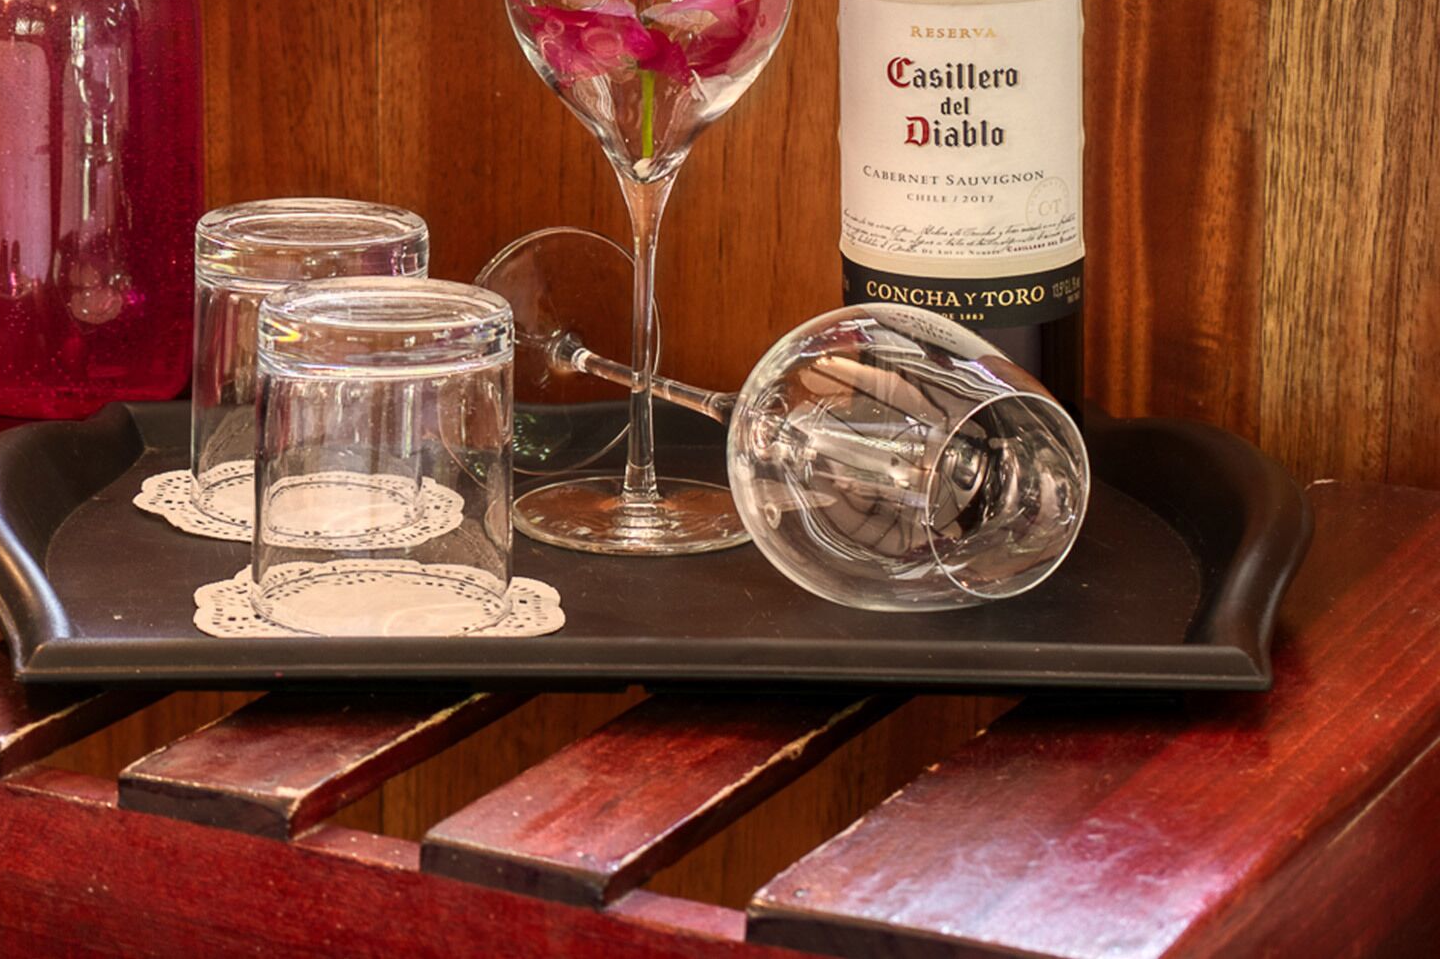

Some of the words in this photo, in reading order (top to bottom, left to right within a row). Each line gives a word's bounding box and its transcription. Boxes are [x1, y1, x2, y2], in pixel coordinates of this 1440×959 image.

[910, 25, 997, 39] RESERVA
[886, 56, 1019, 90] Casillero
[940, 96, 970, 116] del
[903, 116, 1005, 148] Diablo
[862, 165, 940, 186] CABERNET
[945, 169, 1045, 187] SAUVIGNON
[906, 192, 947, 204] CHILE
[962, 194, 995, 204] 2017
[866, 280, 961, 308] CONCHA
[964, 292, 977, 307] Y
[980, 285, 1045, 308] TORO
